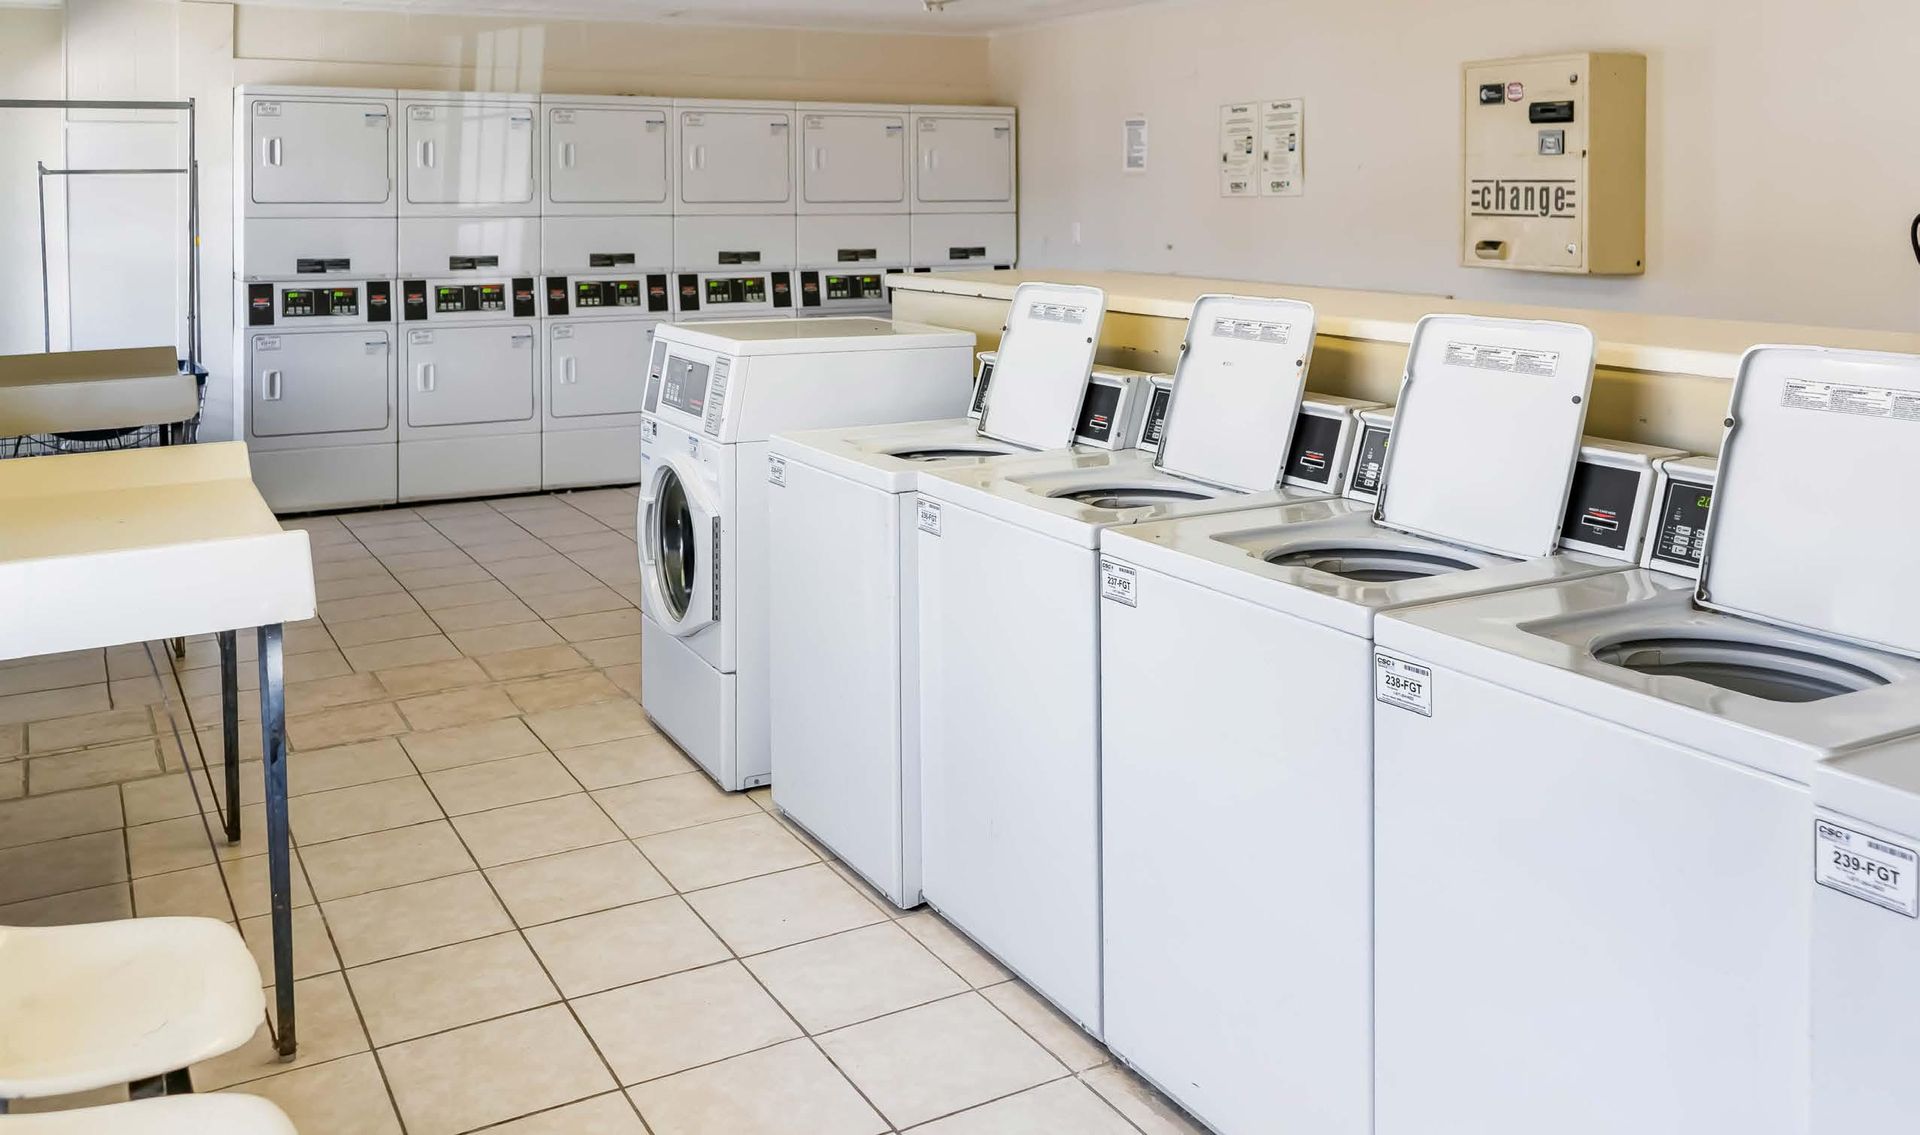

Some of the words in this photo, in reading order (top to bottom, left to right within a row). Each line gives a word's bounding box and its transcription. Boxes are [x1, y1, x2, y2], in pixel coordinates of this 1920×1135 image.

[1481, 180, 1565, 217] change
[1107, 576, 1131, 590] 237-FGT
[1377, 657, 1391, 666] CSC
[1385, 674, 1422, 695] 238-FGT
[1819, 825, 1843, 838] CSC
[1833, 850, 1900, 885] 239-FGT
